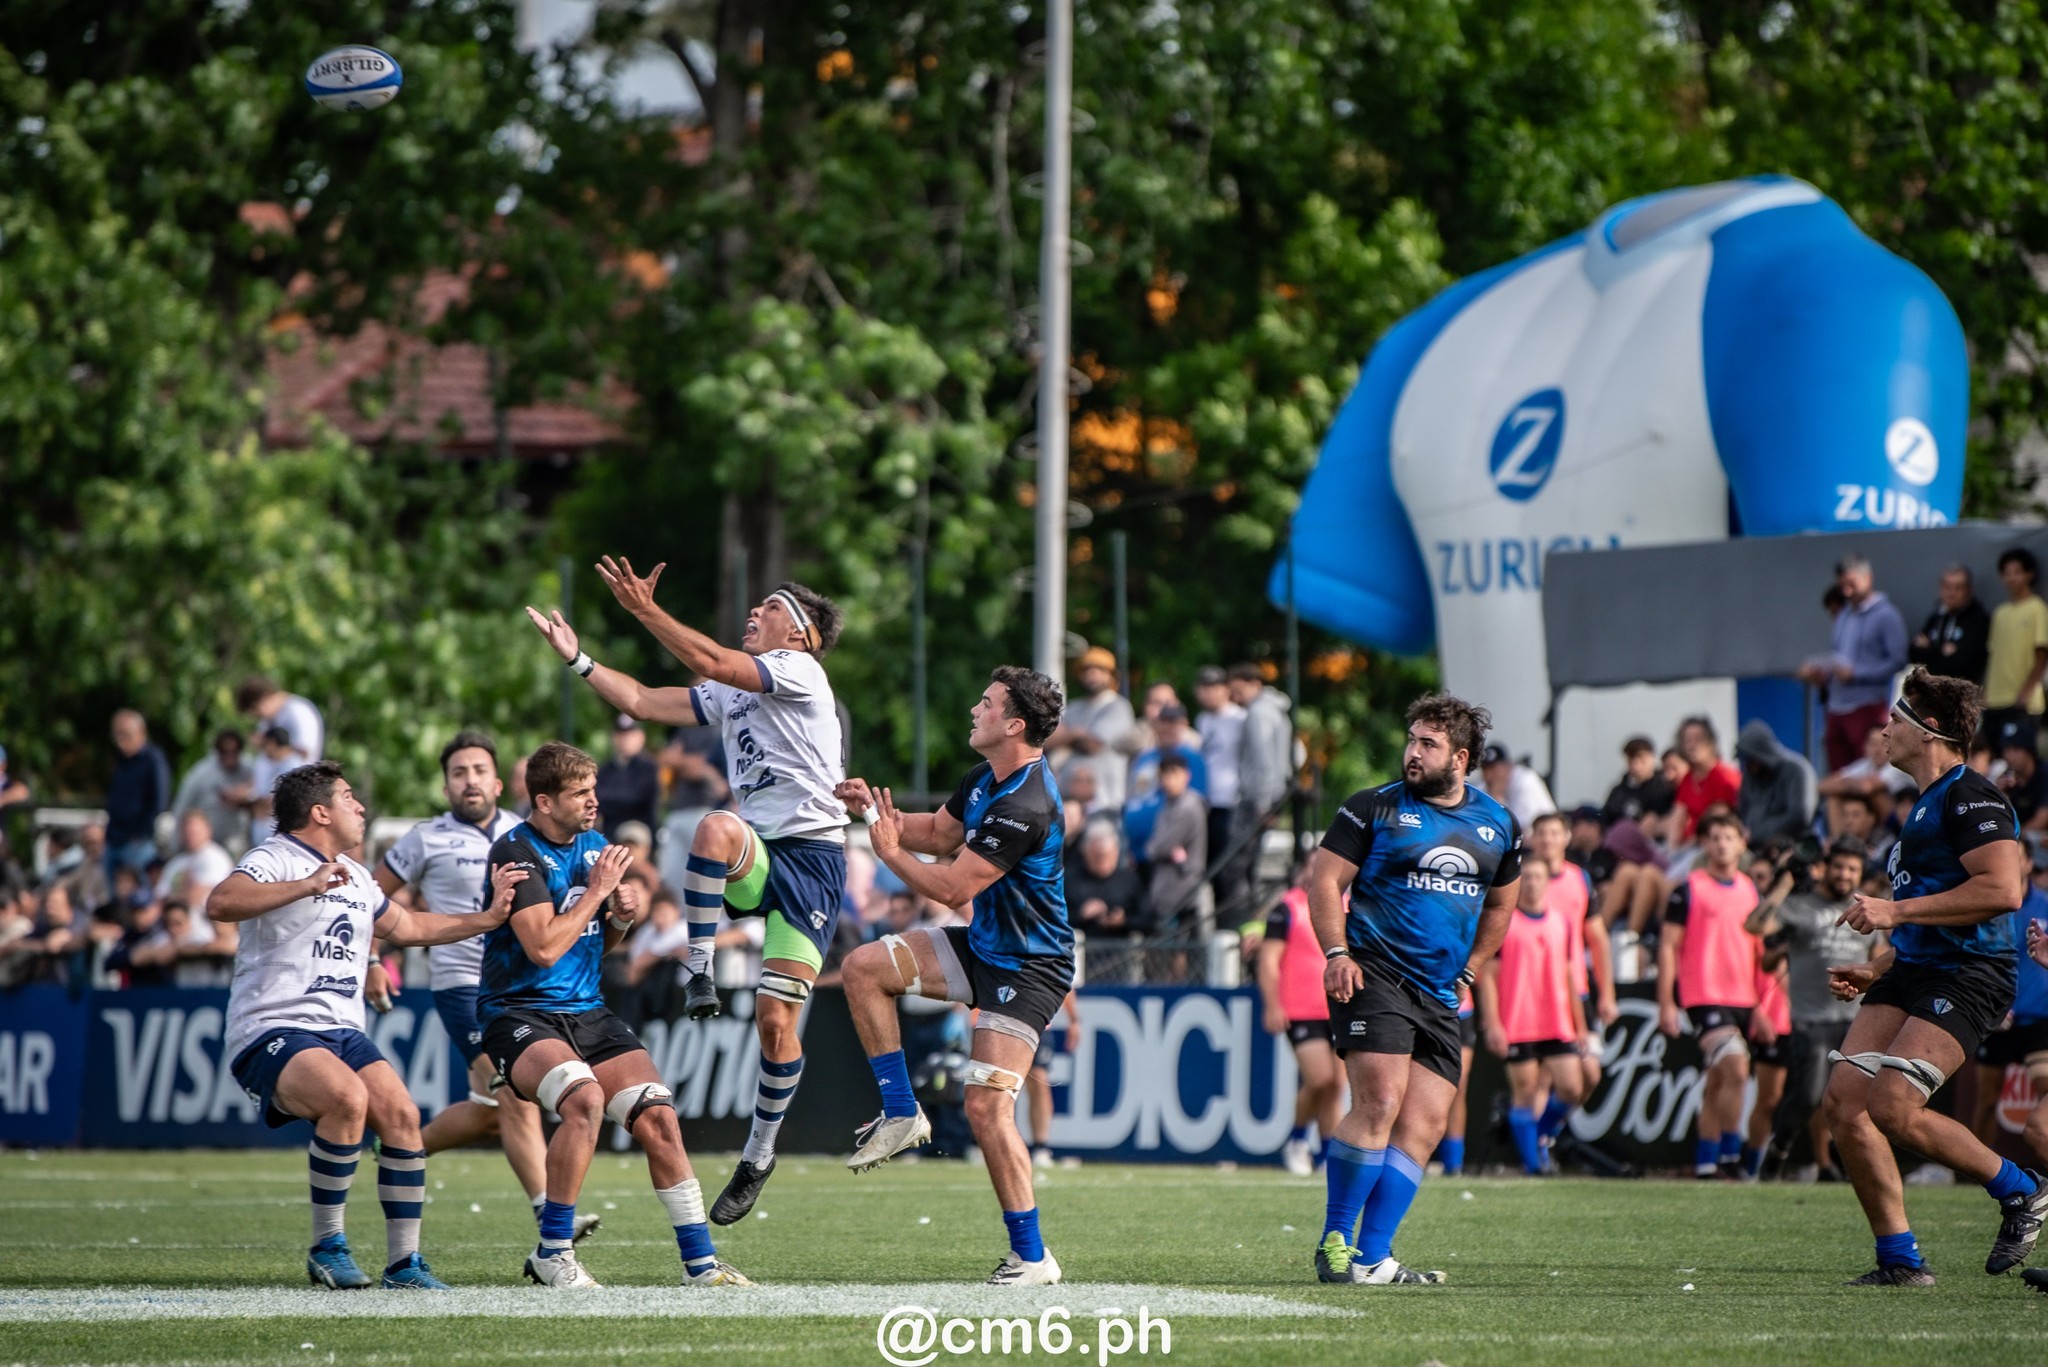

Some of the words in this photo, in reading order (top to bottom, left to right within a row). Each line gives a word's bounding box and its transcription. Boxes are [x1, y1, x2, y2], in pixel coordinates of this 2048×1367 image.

[311, 58, 385, 79] GILBERT
[1434, 535, 1622, 595] ZURI
[1406, 871, 1479, 897] Macro
[1568, 997, 1758, 1144] For
